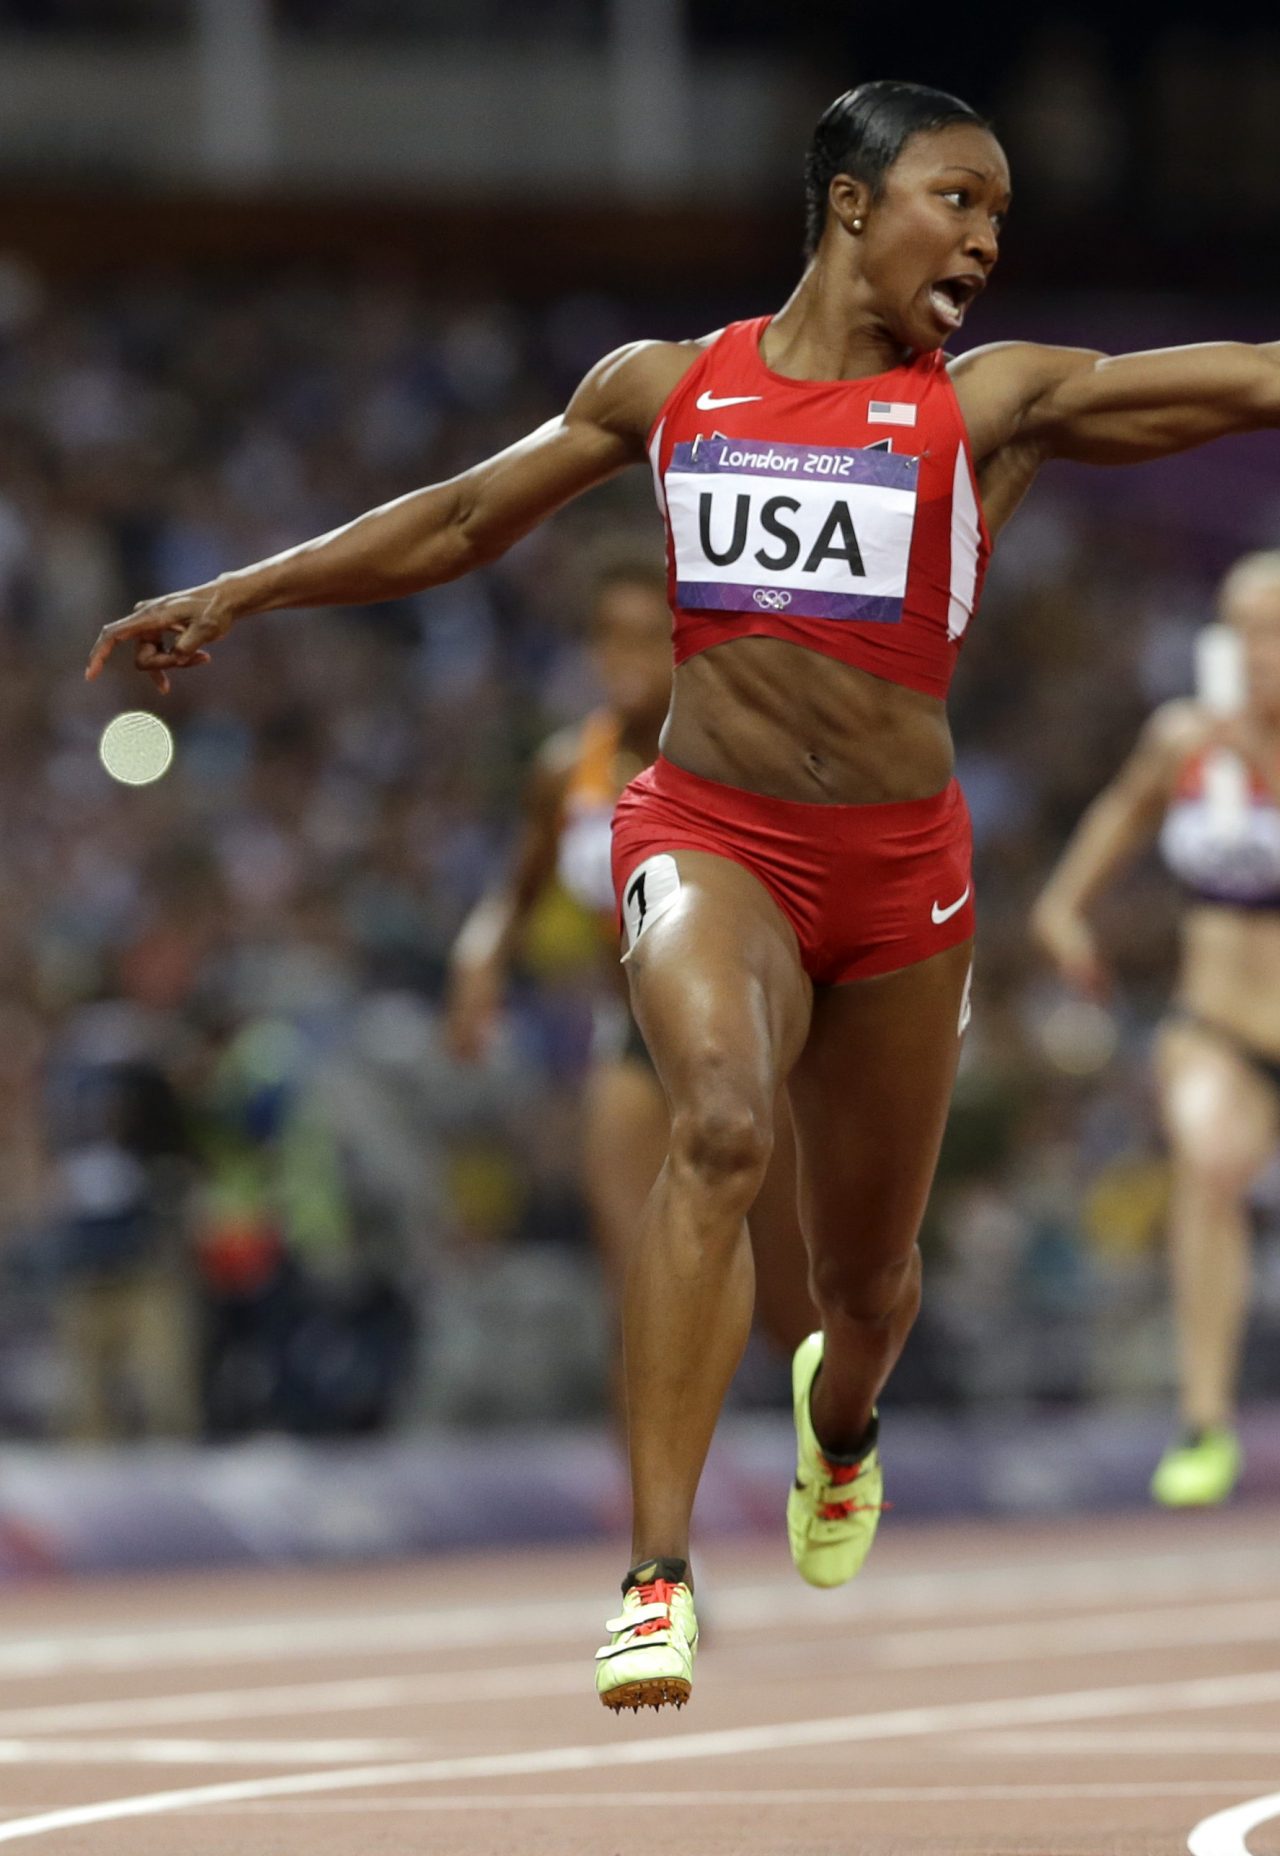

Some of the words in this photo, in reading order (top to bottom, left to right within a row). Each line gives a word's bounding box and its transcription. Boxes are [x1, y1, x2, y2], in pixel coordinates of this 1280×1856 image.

[719, 446, 799, 472] London
[803, 453, 855, 476] 2012
[699, 492, 867, 578] USA
